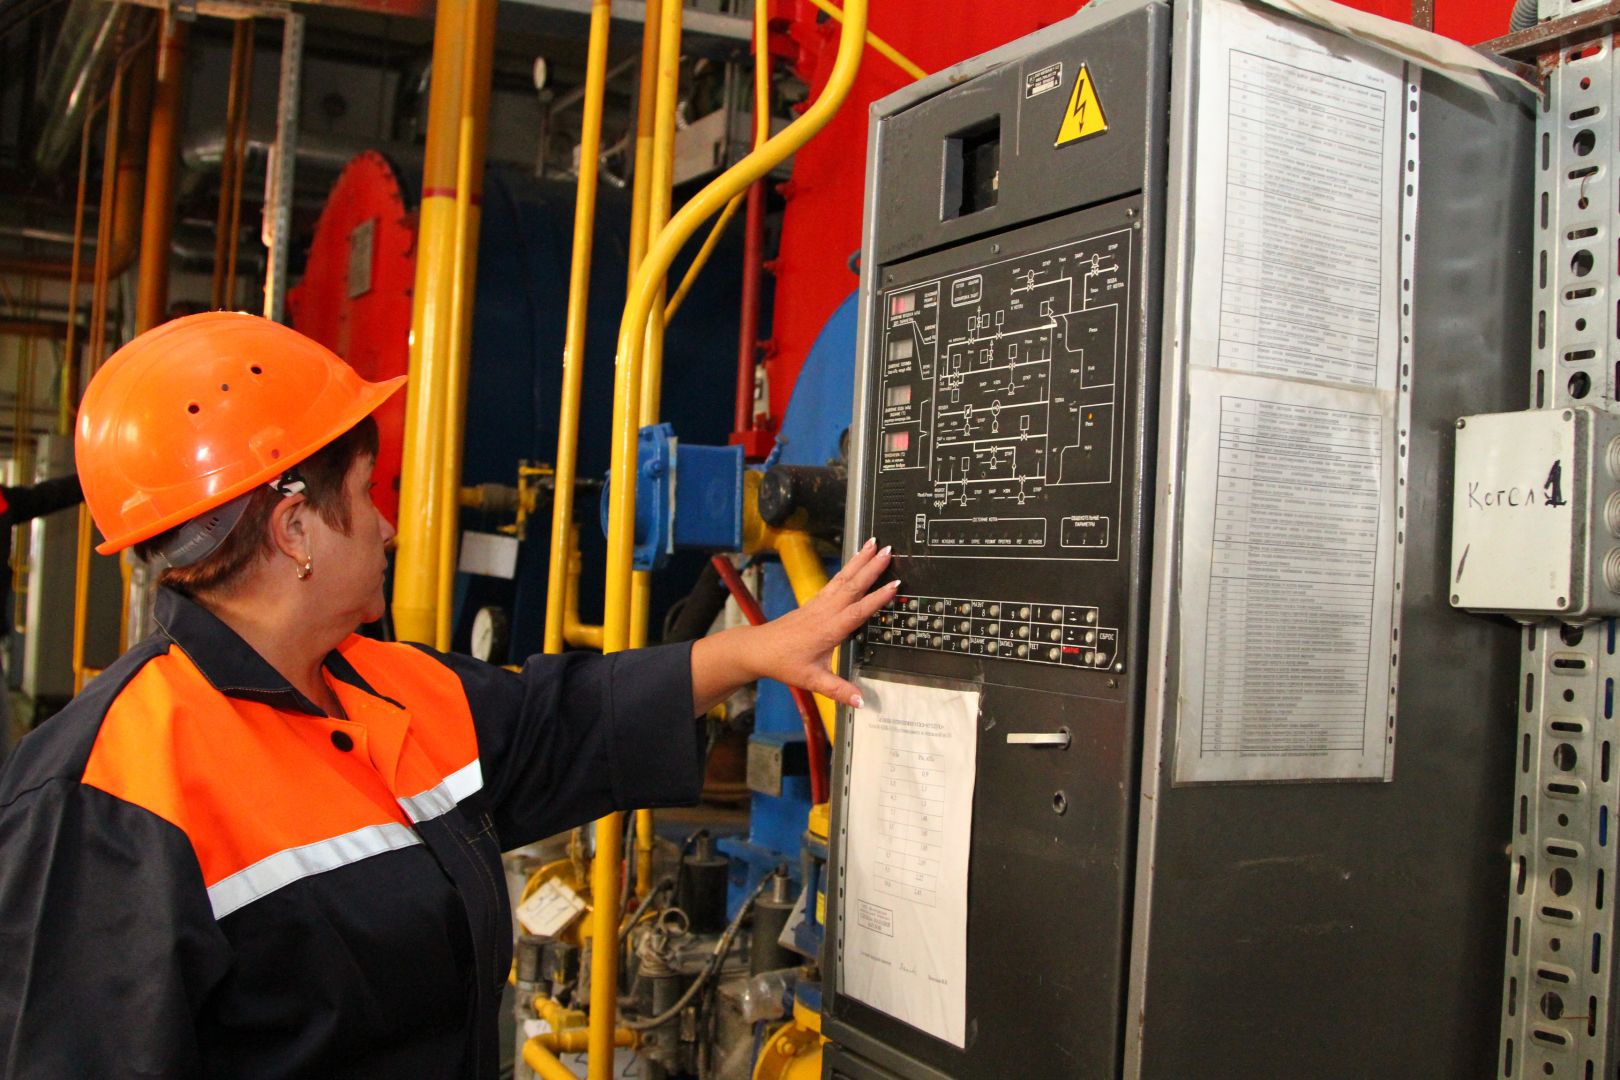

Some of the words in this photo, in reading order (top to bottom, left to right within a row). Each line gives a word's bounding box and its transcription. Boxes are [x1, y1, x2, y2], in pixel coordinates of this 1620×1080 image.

[1544, 459, 1567, 508] 1
[981, 609, 986, 617] 8
[1099, 632, 1114, 641] СБРОС
